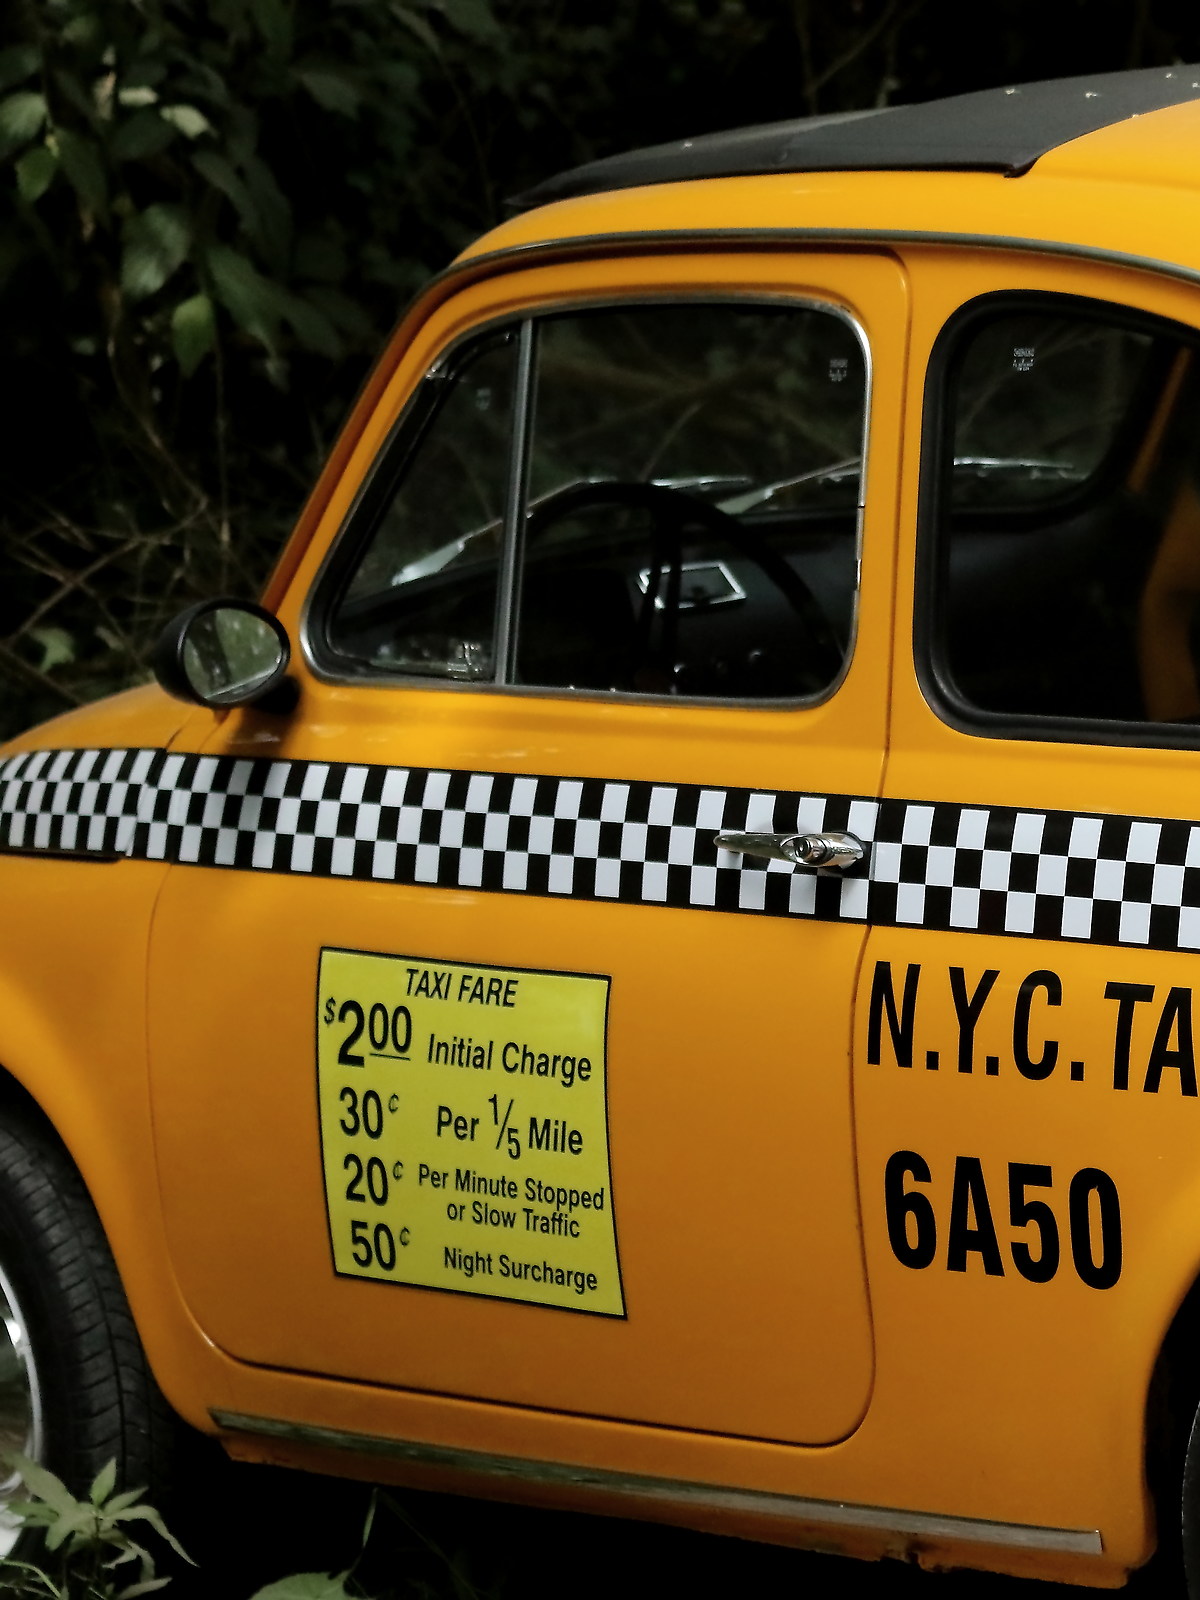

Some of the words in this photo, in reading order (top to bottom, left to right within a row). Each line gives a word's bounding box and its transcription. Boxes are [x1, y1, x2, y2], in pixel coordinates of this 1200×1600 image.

[406, 968, 451, 1000] TAXI
[458, 975, 518, 1008] FARE
[867, 960, 1084, 1082] N.Y.C.
[427, 1033, 494, 1071] Initial
[502, 1041, 592, 1088] Charge
[436, 1105, 479, 1141] Per
[528, 1117, 583, 1155] Mile
[419, 1163, 449, 1189] Per
[455, 1169, 518, 1199] Minute
[525, 1177, 604, 1212] Stopped
[447, 1201, 465, 1223] or
[472, 1200, 516, 1229] Slow
[522, 1208, 581, 1238] Traffic
[884, 1150, 1123, 1290] 6A50
[443, 1246, 493, 1278] Night
[499, 1254, 598, 1295] Surcharge
